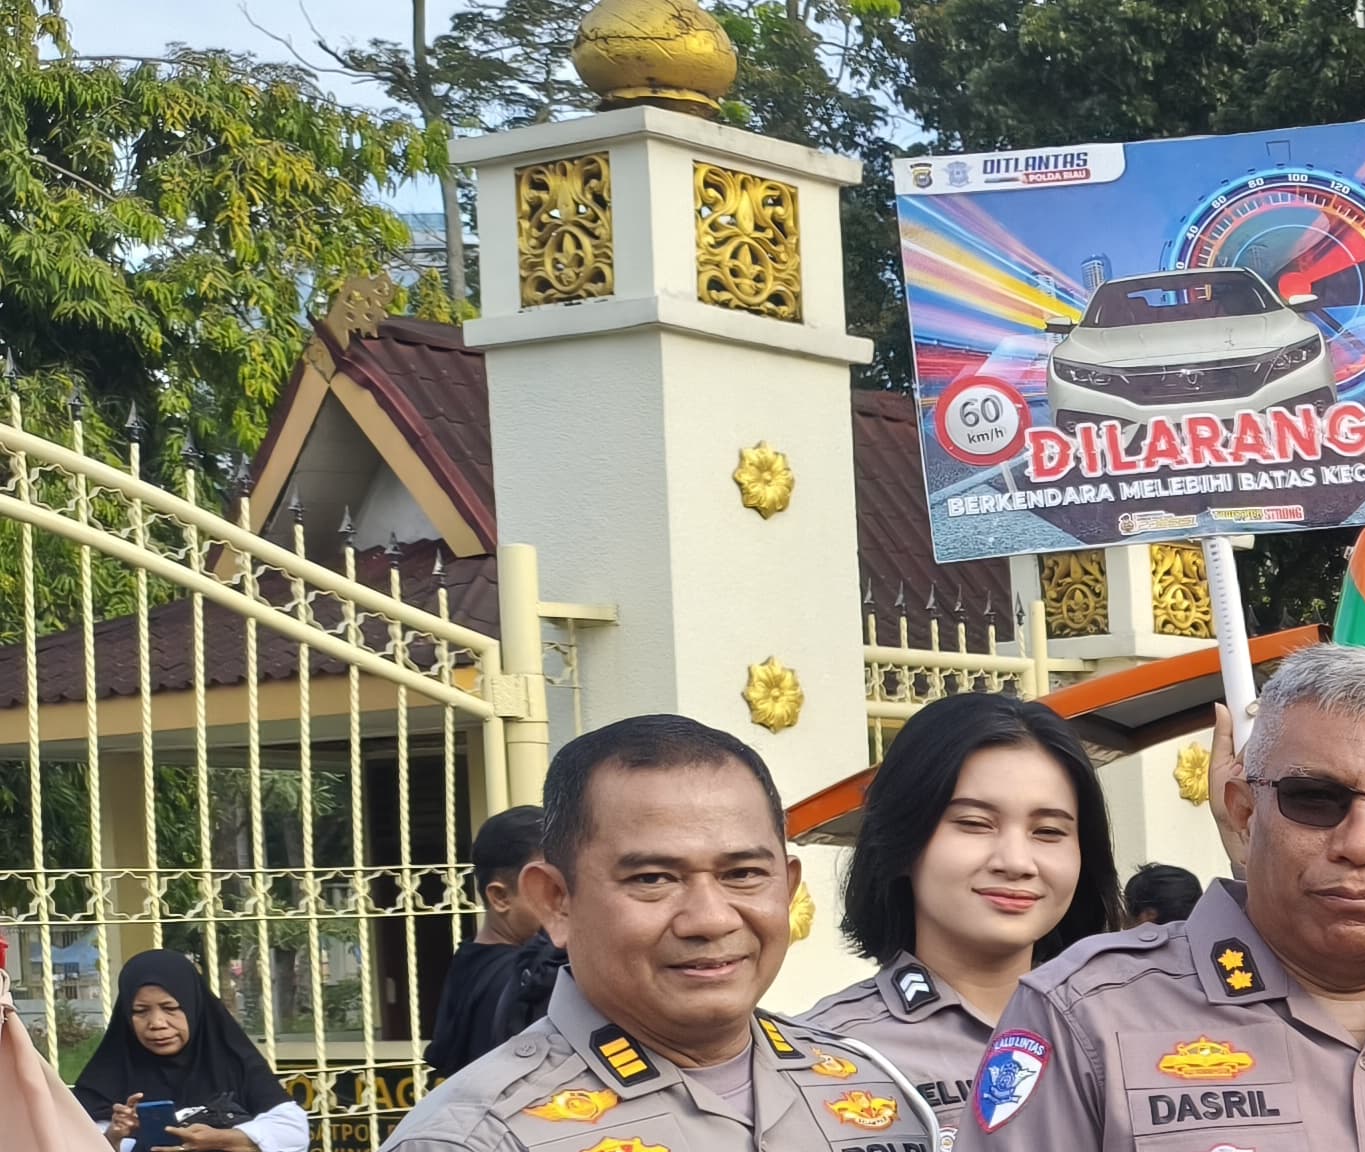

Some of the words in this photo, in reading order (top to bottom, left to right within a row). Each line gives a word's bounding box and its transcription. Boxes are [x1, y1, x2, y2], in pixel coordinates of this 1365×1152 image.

[982, 152, 1088, 175] DITLANTAS
[1248, 177, 1264, 190] 80
[1287, 173, 1309, 183] 100
[1330, 180, 1351, 195] 120
[1186, 225, 1200, 240] 40
[959, 394, 1001, 424] 60
[967, 426, 1005, 446] km/h
[948, 483, 1113, 517] BERKENDARA
[1119, 472, 1232, 501] MELEBIHI
[1239, 467, 1317, 491] BATAS
[1149, 1089, 1280, 1126] DASRIL
